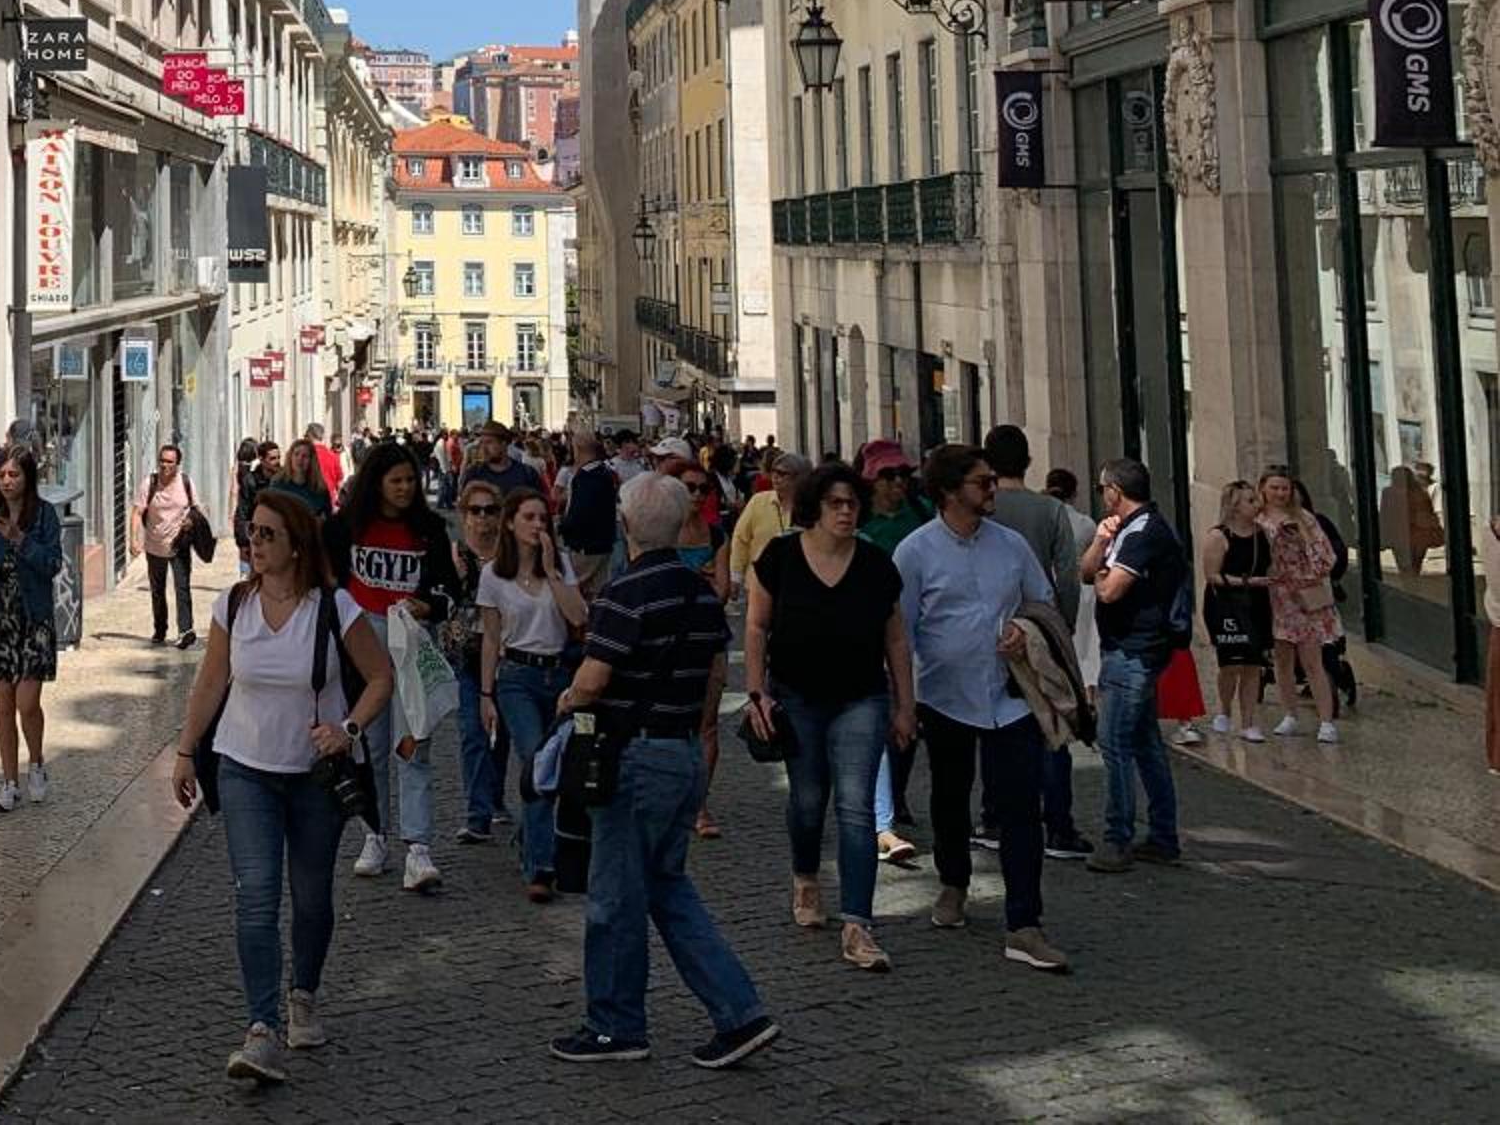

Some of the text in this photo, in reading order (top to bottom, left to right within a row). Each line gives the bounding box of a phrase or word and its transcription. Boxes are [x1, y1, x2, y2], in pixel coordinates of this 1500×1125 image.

[29, 32, 85, 44] ZARA
[27, 49, 85, 60] HOME
[177, 70, 195, 80] DO
[1405, 53, 1431, 113] GMS
[207, 85, 216, 94] O
[1015, 132, 1030, 167] GMS
[355, 548, 420, 583] EGYP
